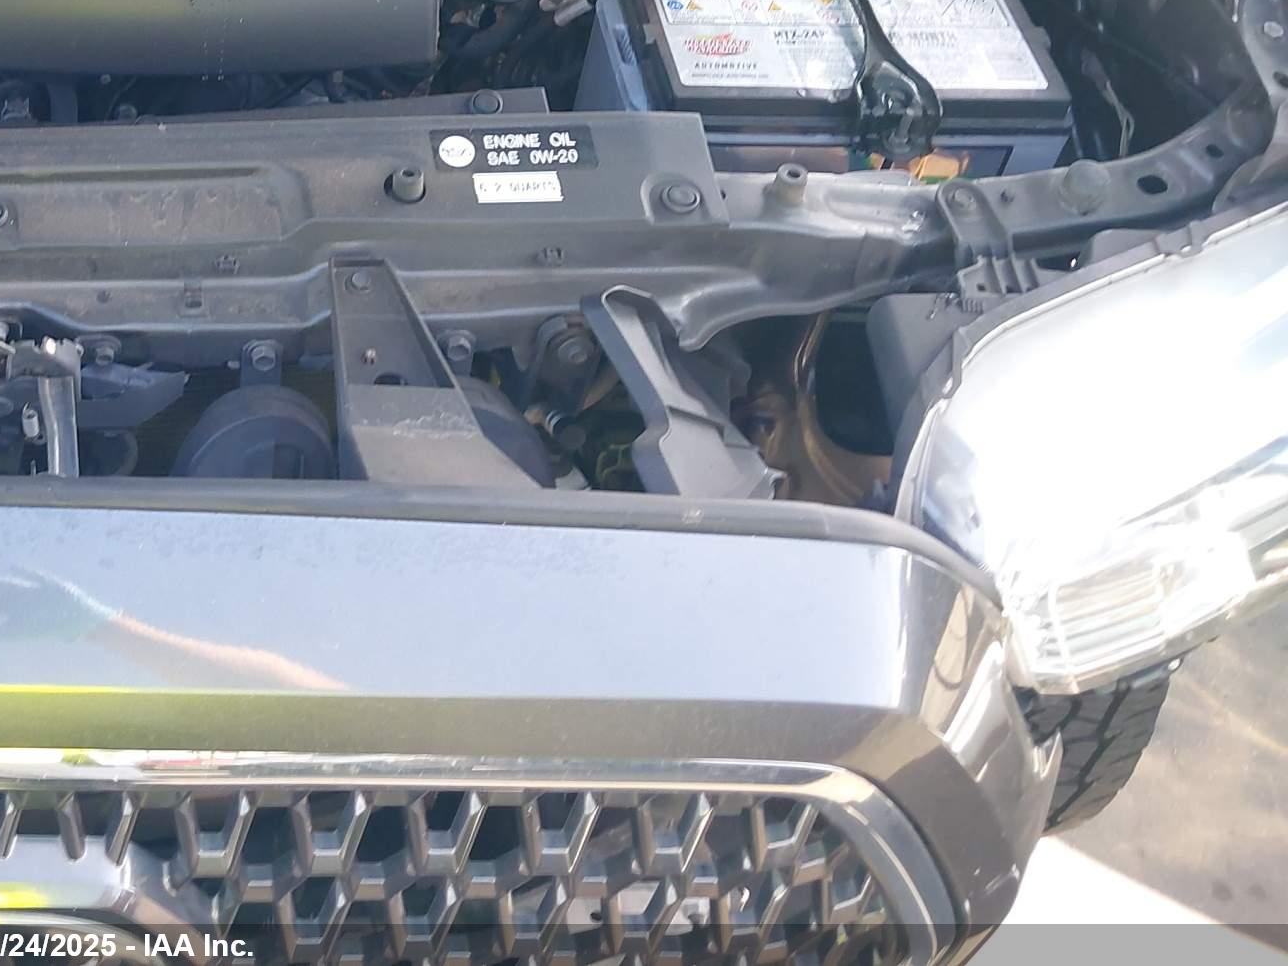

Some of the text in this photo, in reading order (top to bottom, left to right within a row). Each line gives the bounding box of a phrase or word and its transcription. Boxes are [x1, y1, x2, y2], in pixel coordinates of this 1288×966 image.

[483, 132, 577, 149] ENGINE OIL
[487, 151, 520, 165] SAE
[530, 149, 579, 164] 0W-20
